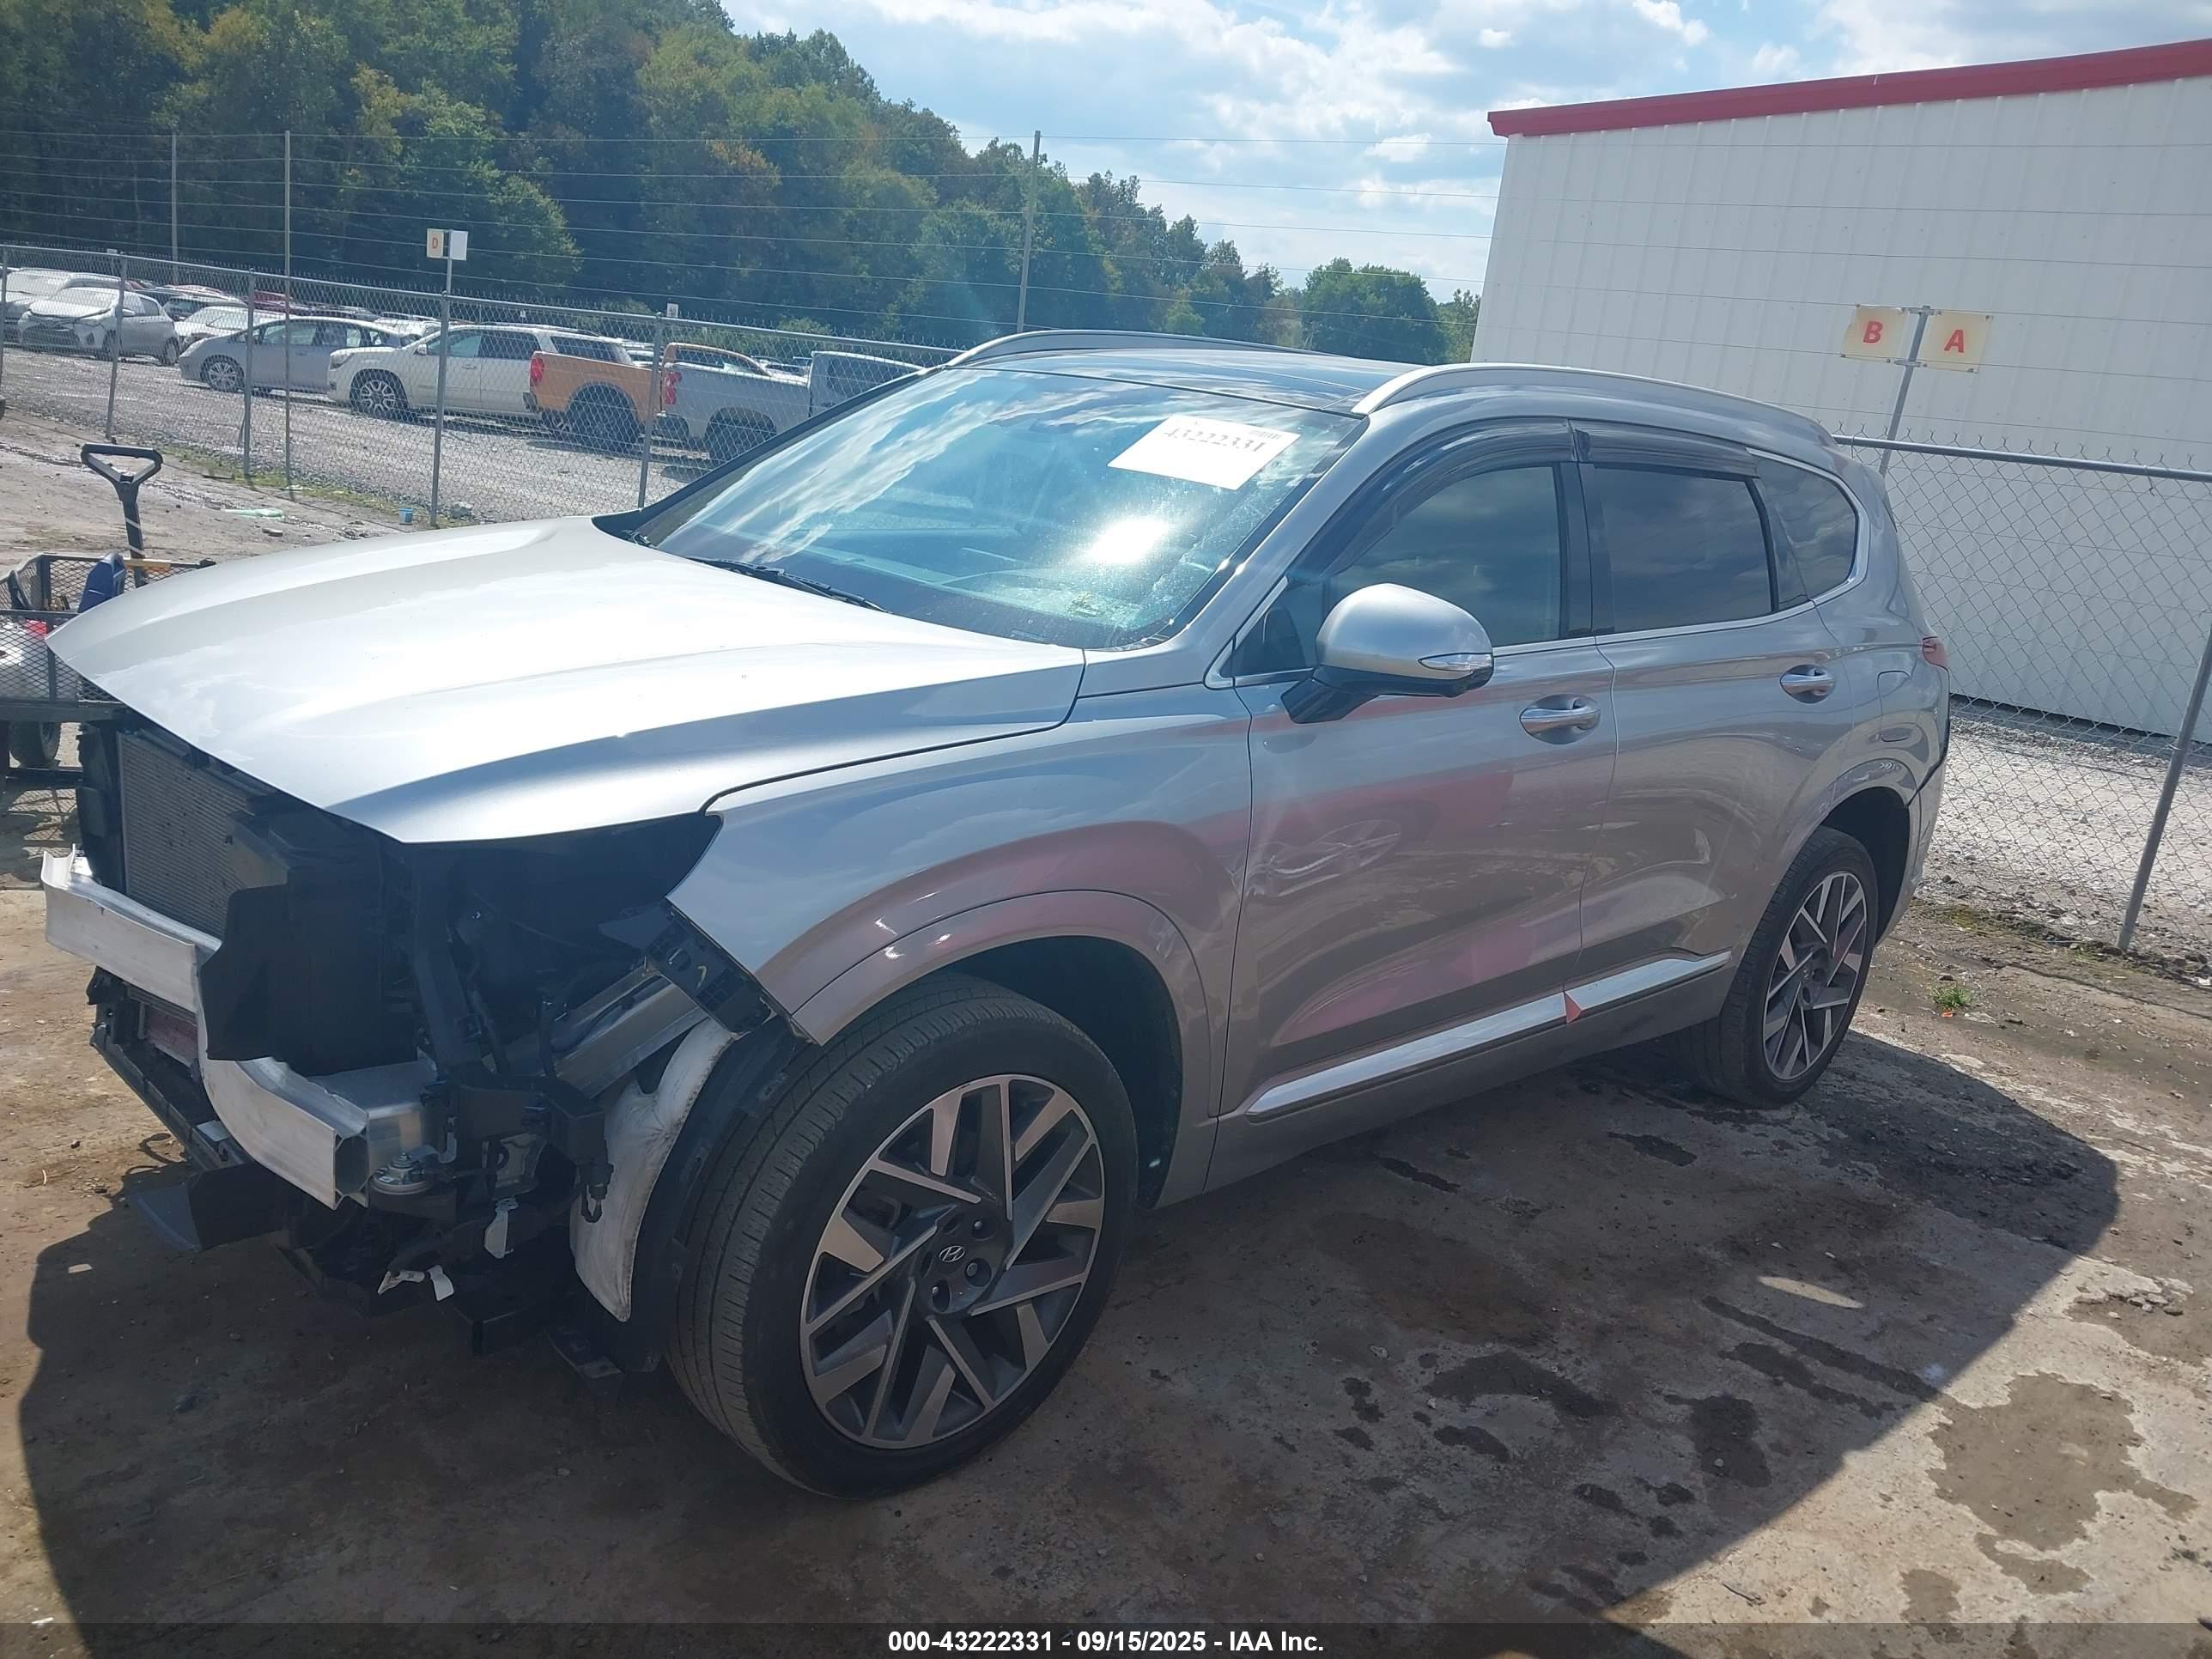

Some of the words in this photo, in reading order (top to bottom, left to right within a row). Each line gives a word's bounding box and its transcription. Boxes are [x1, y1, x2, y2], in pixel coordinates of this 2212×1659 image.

[432, 237, 439, 249] D
[1863, 320, 1883, 344] B
[1943, 329, 1965, 354] A
[1164, 428, 1266, 453] 43222331
